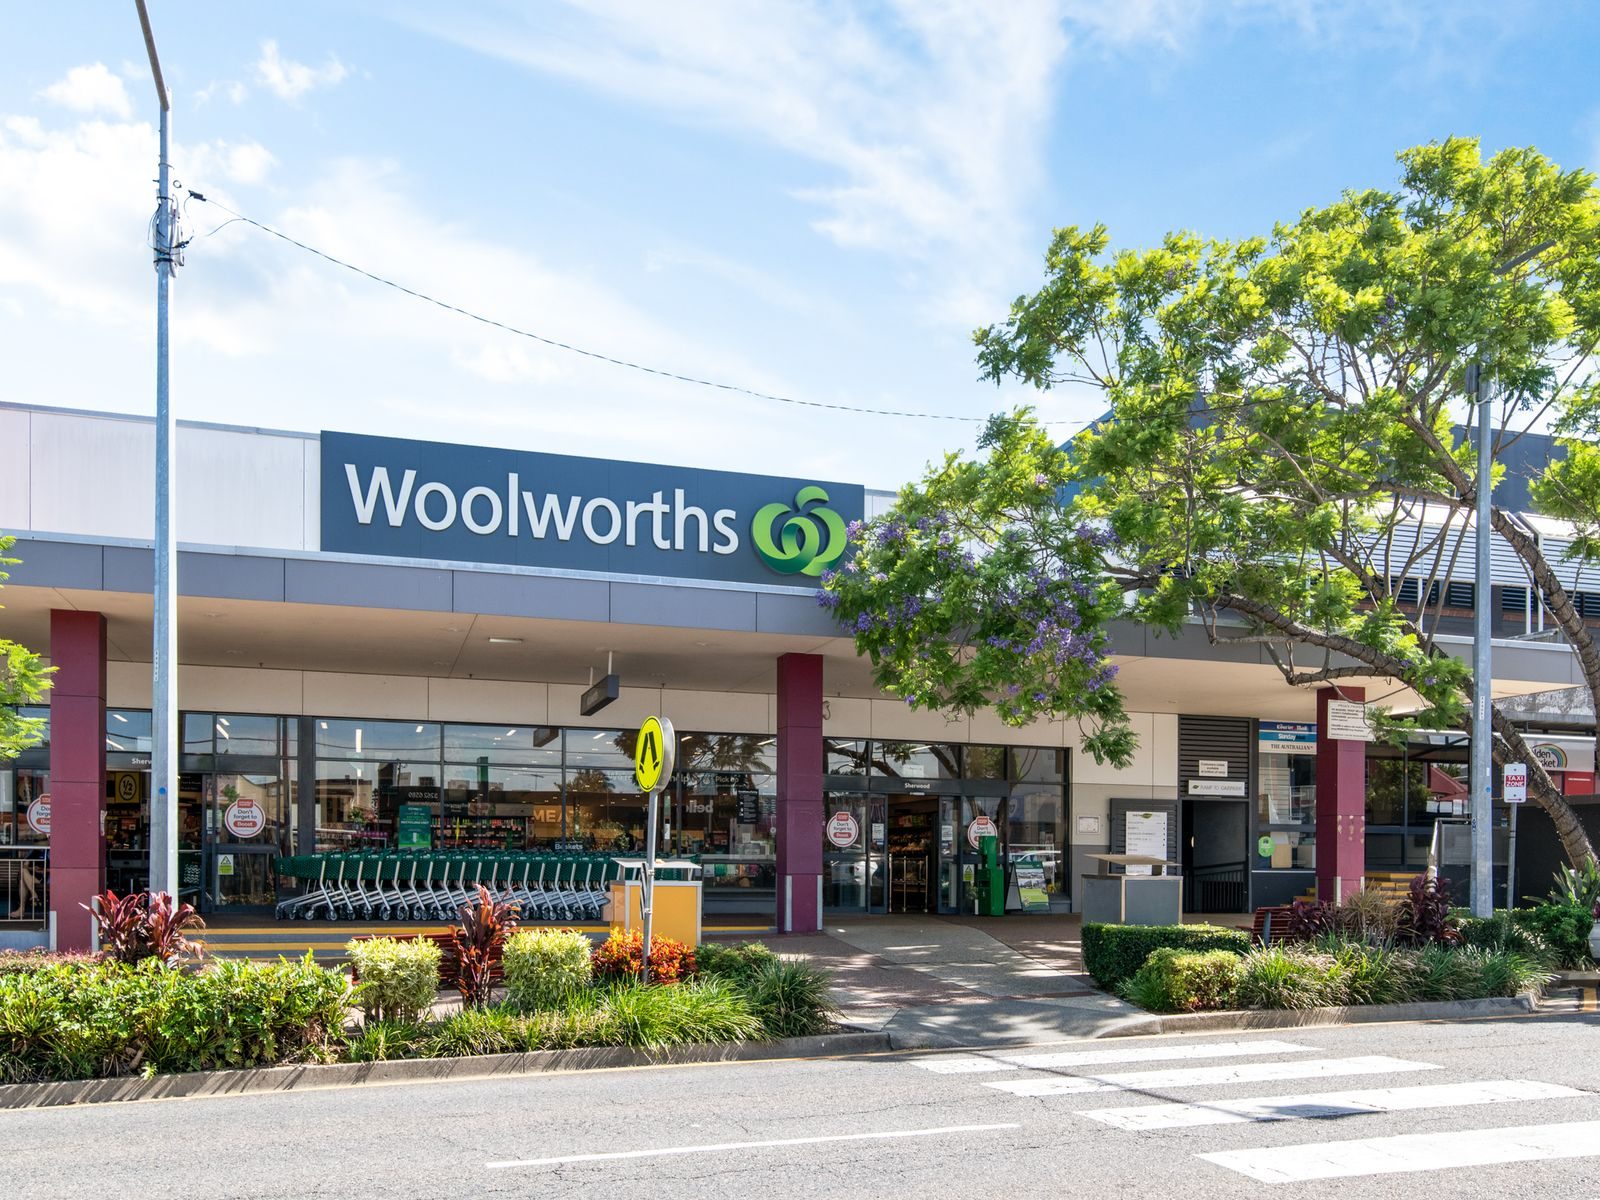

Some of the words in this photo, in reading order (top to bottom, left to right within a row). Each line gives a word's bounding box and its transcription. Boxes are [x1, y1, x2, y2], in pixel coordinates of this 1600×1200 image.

[344, 463, 740, 555] Woolworths
[1278, 733, 1297, 741] Sunday
[1533, 748, 1551, 759] lden
